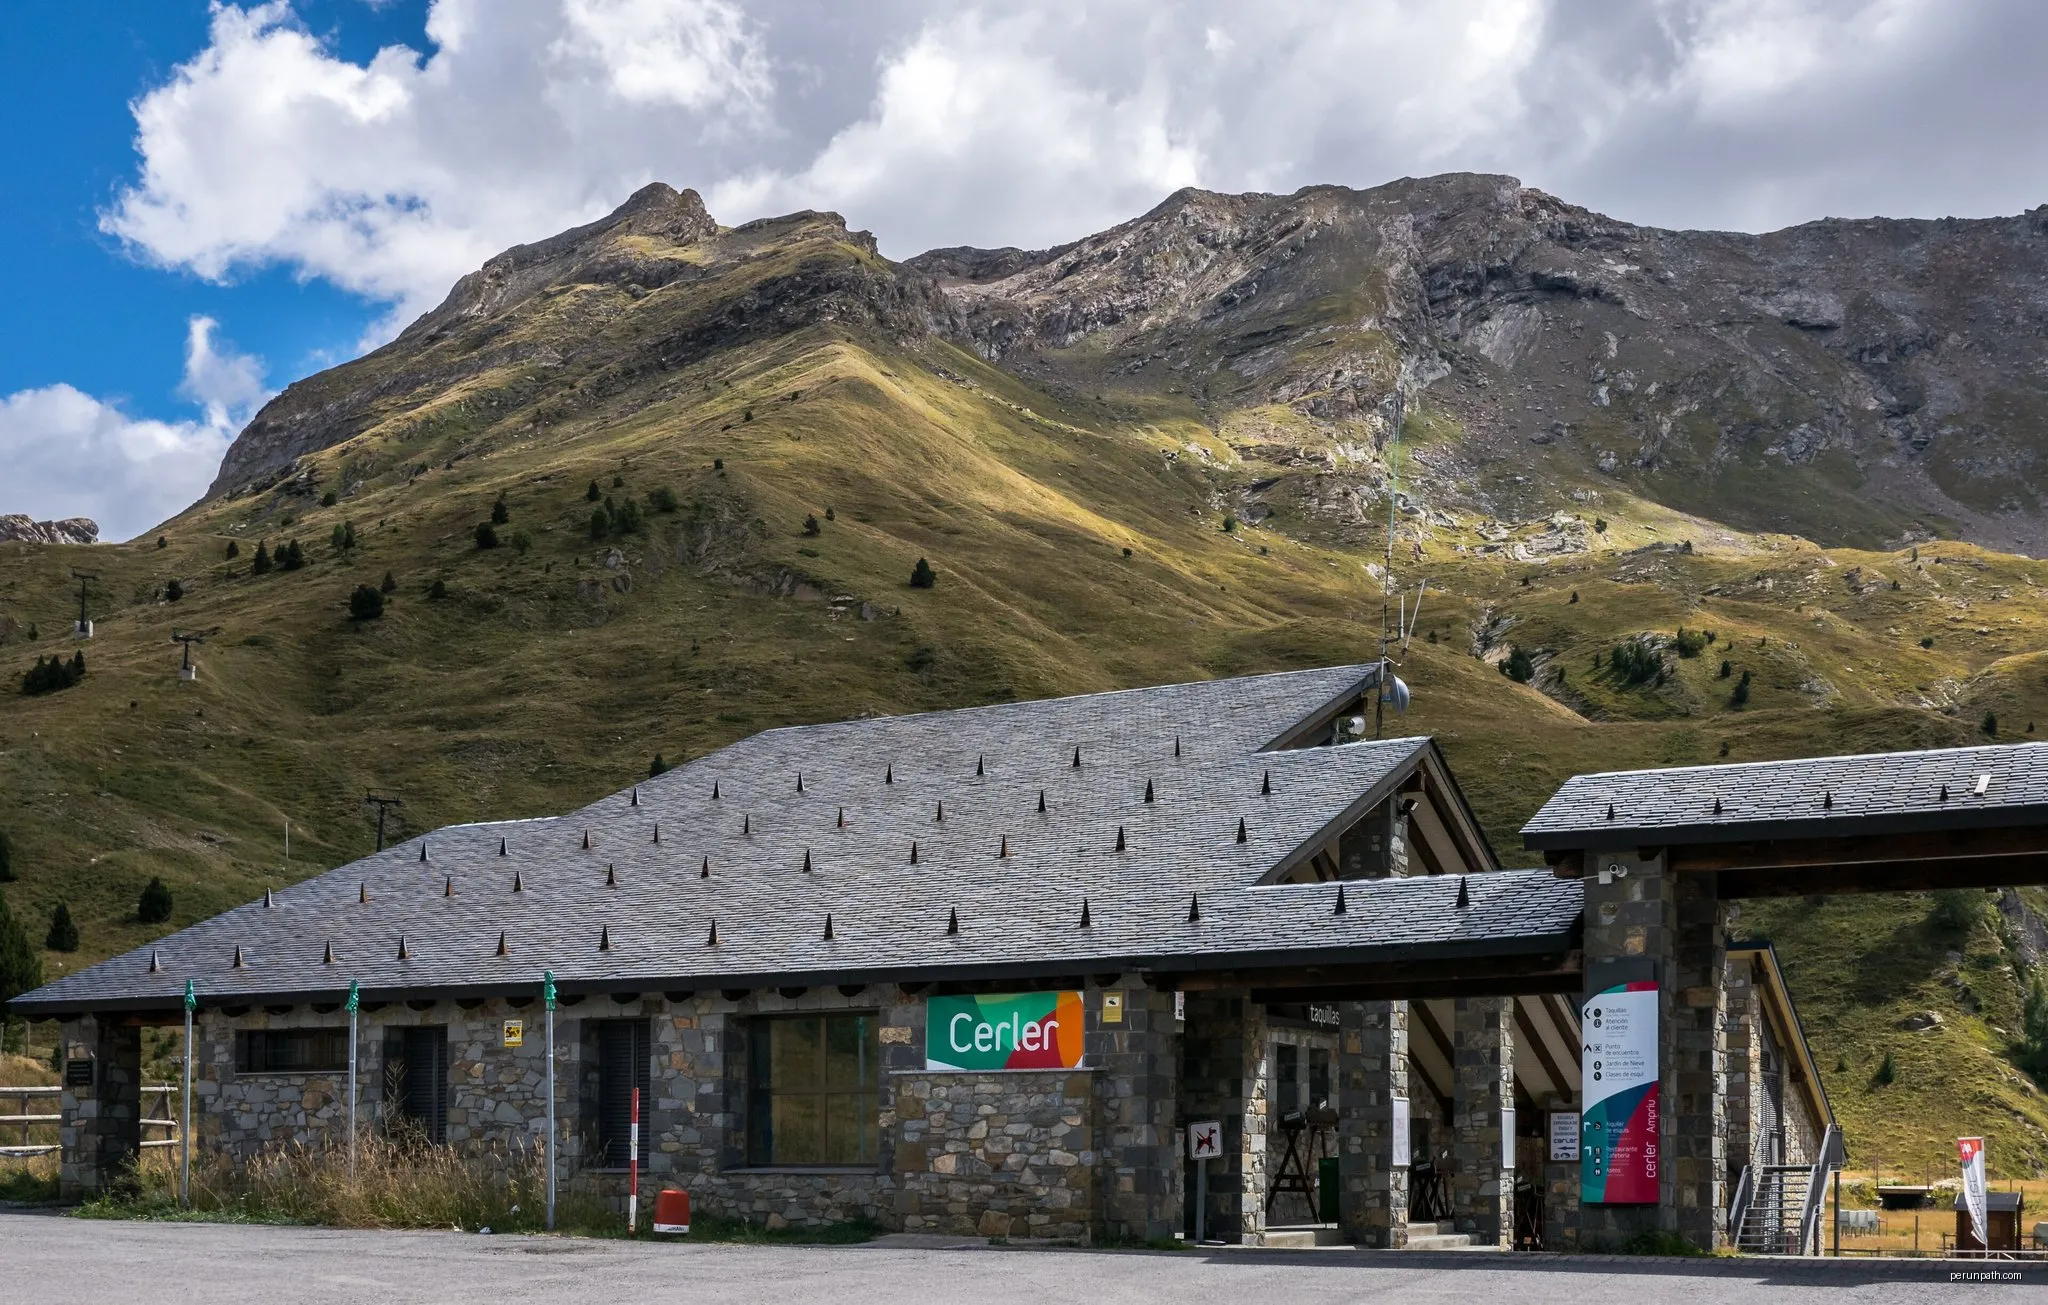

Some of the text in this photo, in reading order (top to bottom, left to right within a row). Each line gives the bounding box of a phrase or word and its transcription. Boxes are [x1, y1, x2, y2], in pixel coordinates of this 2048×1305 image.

[949, 1011, 1060, 1053] Cerler
[1310, 1004, 1340, 1027] taquillas
[1643, 1099, 1657, 1178] cerler Ampriu
